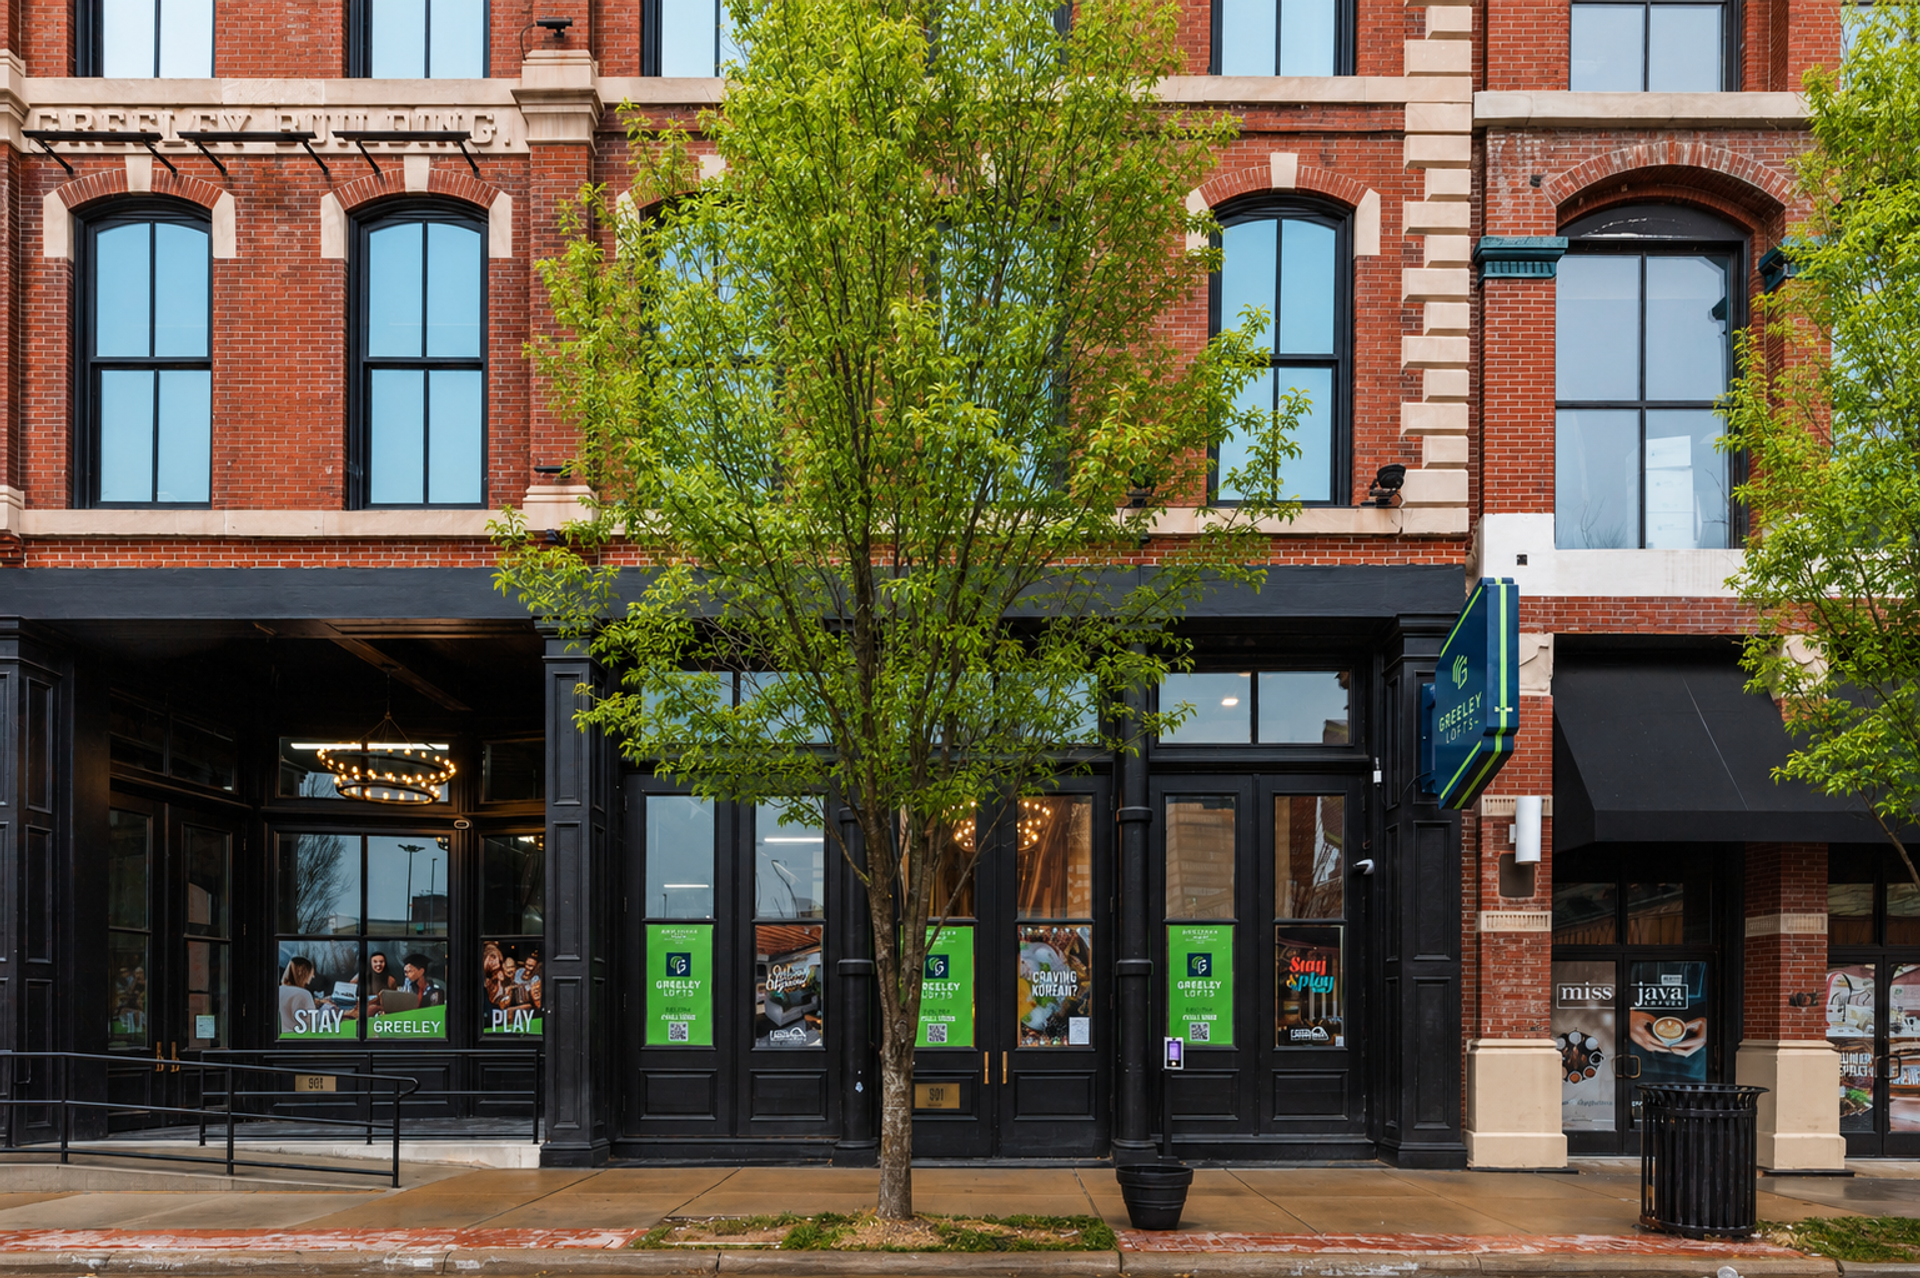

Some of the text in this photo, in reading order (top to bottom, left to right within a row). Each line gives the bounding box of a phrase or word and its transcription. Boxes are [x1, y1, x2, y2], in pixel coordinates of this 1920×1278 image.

[34, 110, 252, 147] GREELEY
[1439, 692, 1482, 732] GREELEY
[1032, 971, 1077, 983] CRAVING
[656, 980, 701, 990] GREELEY
[922, 982, 960, 991] REELEY
[1031, 984, 1078, 997] KOREAN?
[1177, 980, 1222, 990] GREELEY
[1560, 981, 1684, 1007] miss java
[293, 1009, 345, 1034] STAY
[373, 1020, 441, 1034] GREELEY
[492, 1009, 535, 1033] PLAY
